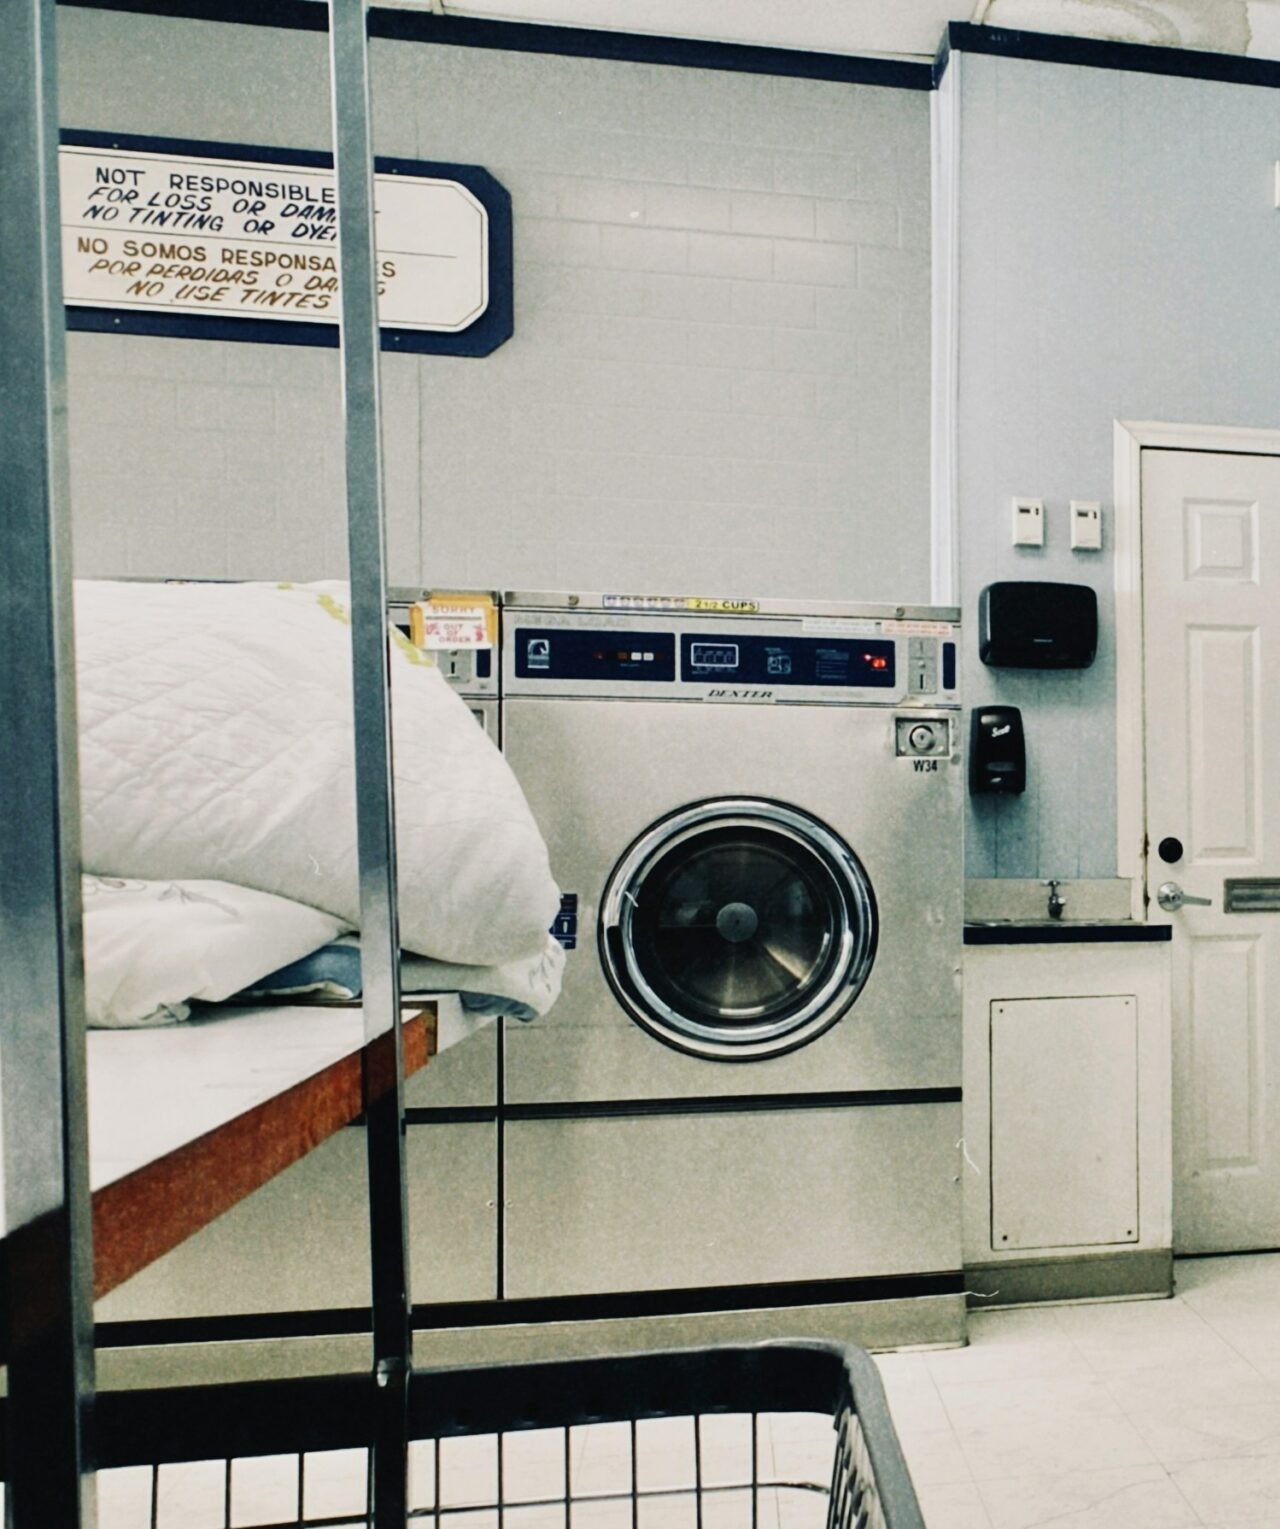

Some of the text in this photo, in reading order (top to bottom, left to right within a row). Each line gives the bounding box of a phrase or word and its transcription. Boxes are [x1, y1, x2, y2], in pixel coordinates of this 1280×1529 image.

[96, 167, 336, 204] NOT RESPONSIBLE
[88, 186, 140, 205] FOR
[147, 191, 212, 212] LOSS
[232, 198, 266, 217] OR
[82, 205, 119, 221] NO
[128, 207, 224, 232] TINTING
[243, 219, 275, 236] OR
[77, 237, 396, 278] NO SOMOS RESPONSAS
[87, 258, 142, 277] POR
[146, 263, 259, 285] PERDIDAS
[275, 273, 293, 288] O
[125, 280, 332, 310] NO USE TINTES
[722, 601, 756, 610] CUPS
[708, 689, 774, 699] DEXTER
[913, 759, 938, 773] W34
